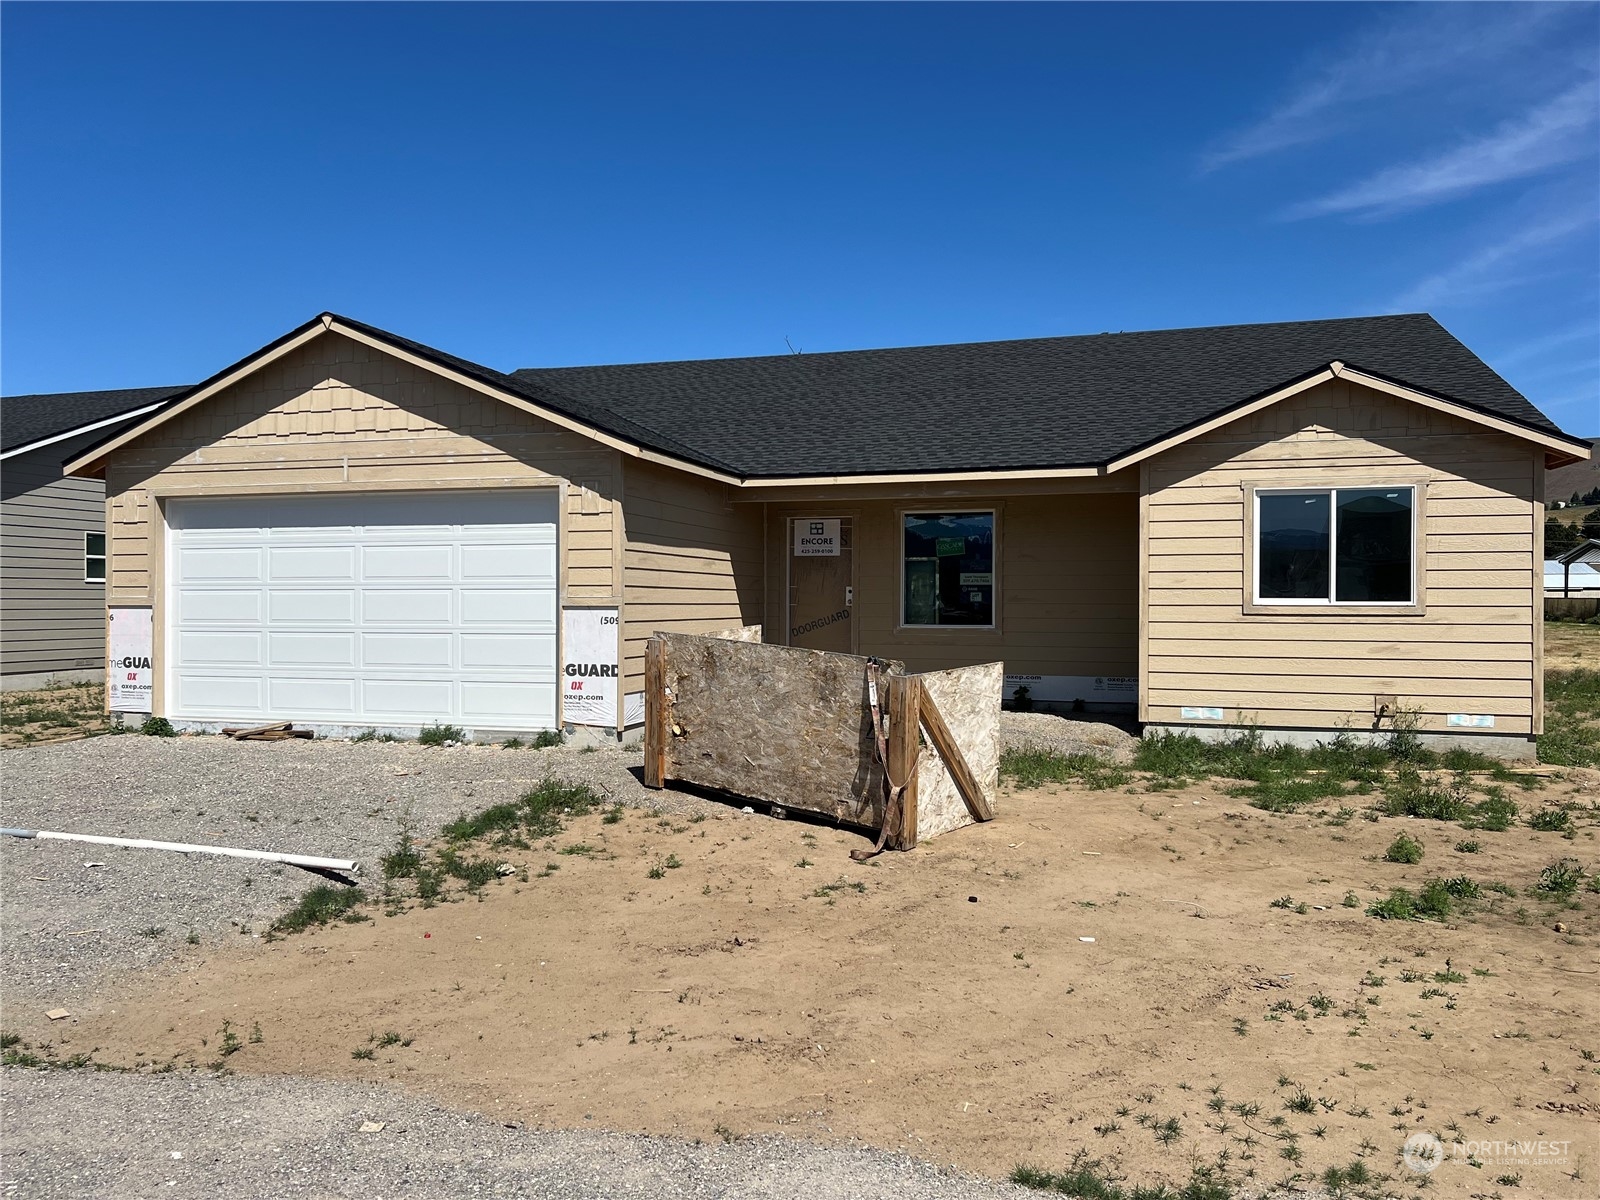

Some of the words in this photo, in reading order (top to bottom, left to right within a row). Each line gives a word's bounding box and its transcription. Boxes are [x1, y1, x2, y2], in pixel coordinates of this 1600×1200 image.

[109, 613, 115, 622] 6
[791, 609, 850, 637] DOORGUARD
[109, 656, 153, 669] meGUA
[562, 663, 619, 677] GUARD
[127, 672, 138, 681] OX
[570, 681, 584, 690] OX
